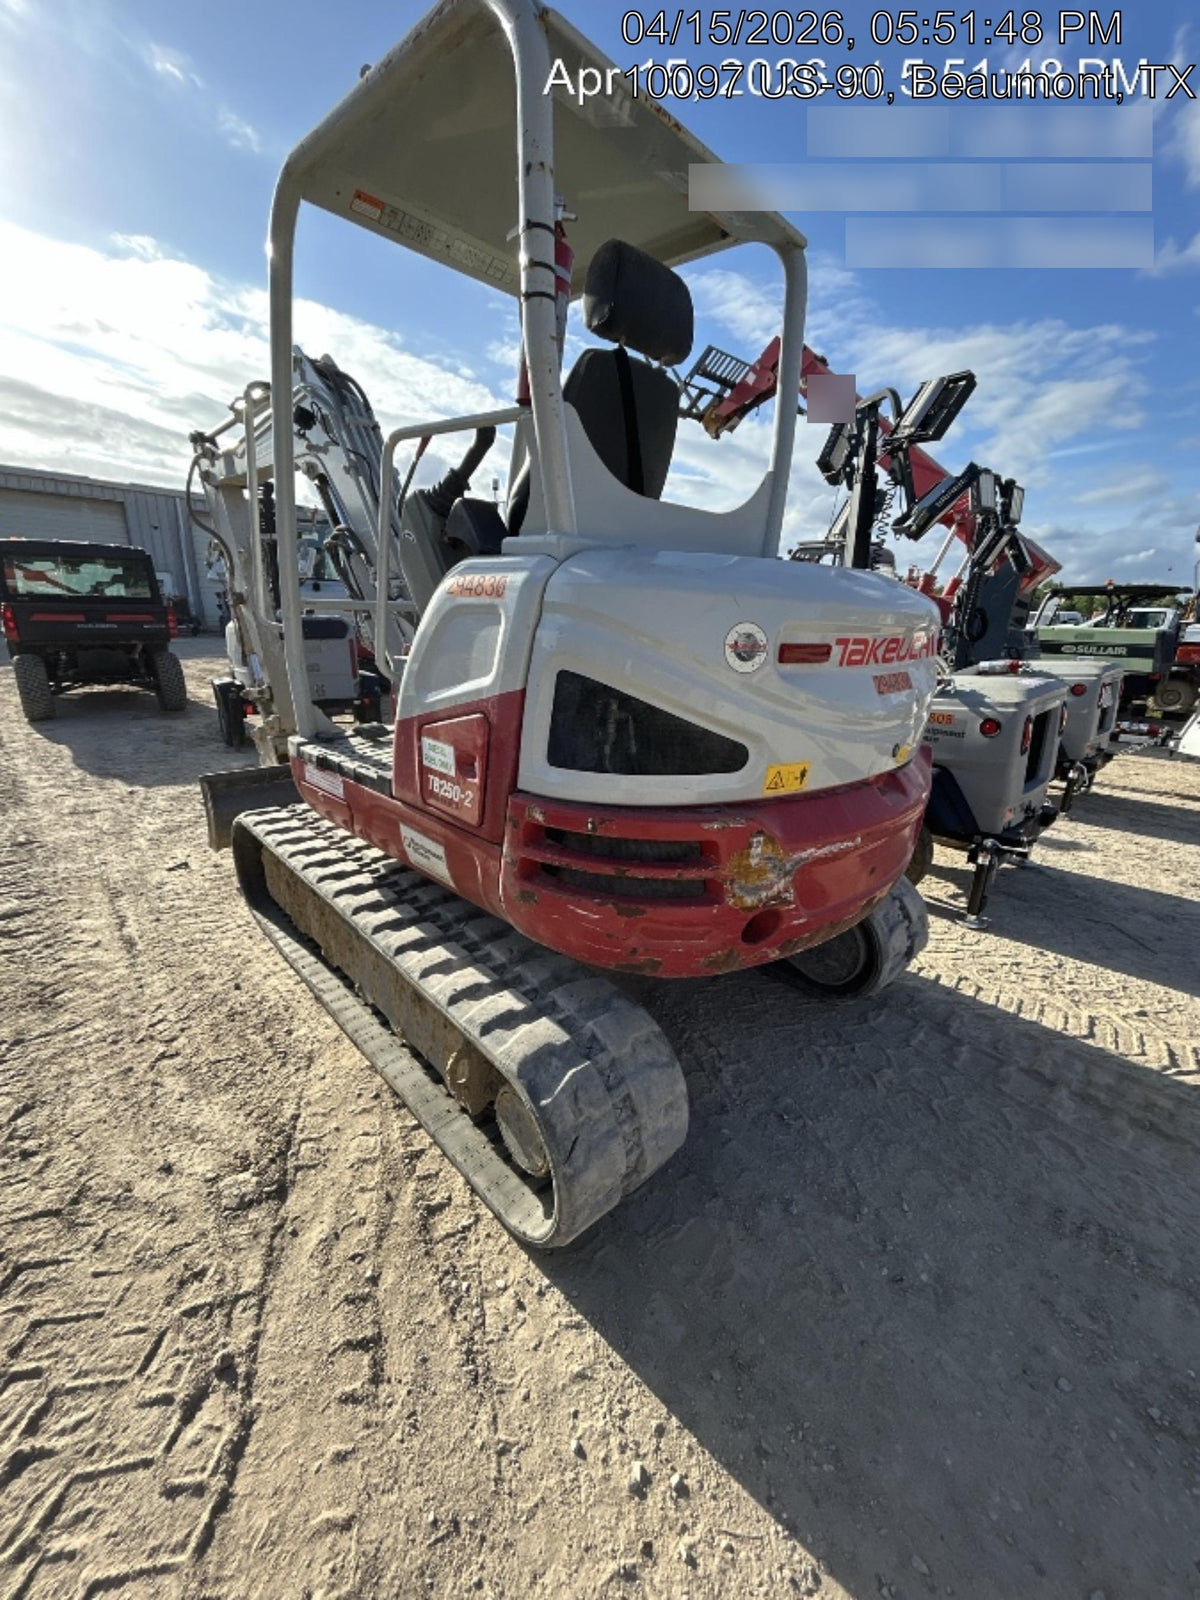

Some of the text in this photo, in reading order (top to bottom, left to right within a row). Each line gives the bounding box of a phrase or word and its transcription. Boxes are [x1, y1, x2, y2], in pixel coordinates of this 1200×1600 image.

[835, 633, 936, 667] TAKEUCHI
[1076, 645, 1128, 656] SULLAIR
[428, 774, 474, 808] TB250-2
